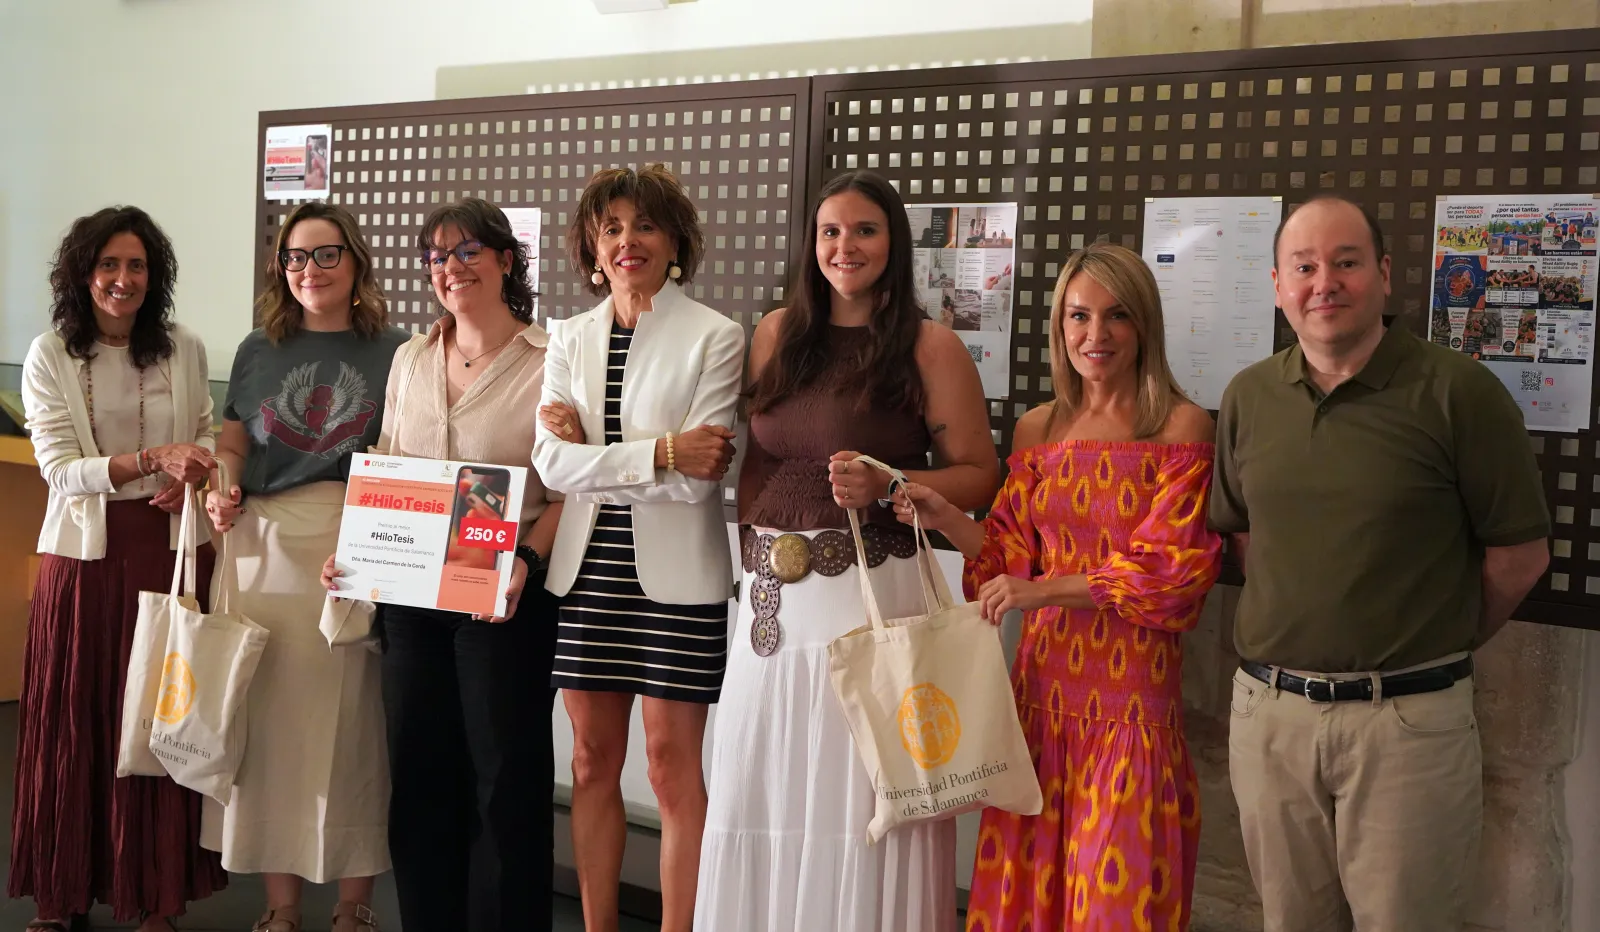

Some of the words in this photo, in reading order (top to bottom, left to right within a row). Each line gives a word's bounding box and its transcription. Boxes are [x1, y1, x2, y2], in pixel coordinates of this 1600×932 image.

[335, 438, 359, 452] TOUR
[359, 492, 445, 514] #HiloTesis
[371, 531, 415, 544] #HiloTesis
[465, 526, 493, 542] 250
[495, 530, 506, 543] €
[359, 543, 383, 551] Universidad
[384, 545, 403, 553] Pontificia
[411, 548, 435, 556] Salamanca
[152, 747, 188, 766] manca
[163, 734, 211, 760] Pontificia
[879, 776, 947, 801] Universidad
[950, 760, 1008, 788] Pontificia
[903, 803, 918, 817] de
[921, 788, 989, 815] Salamanca
